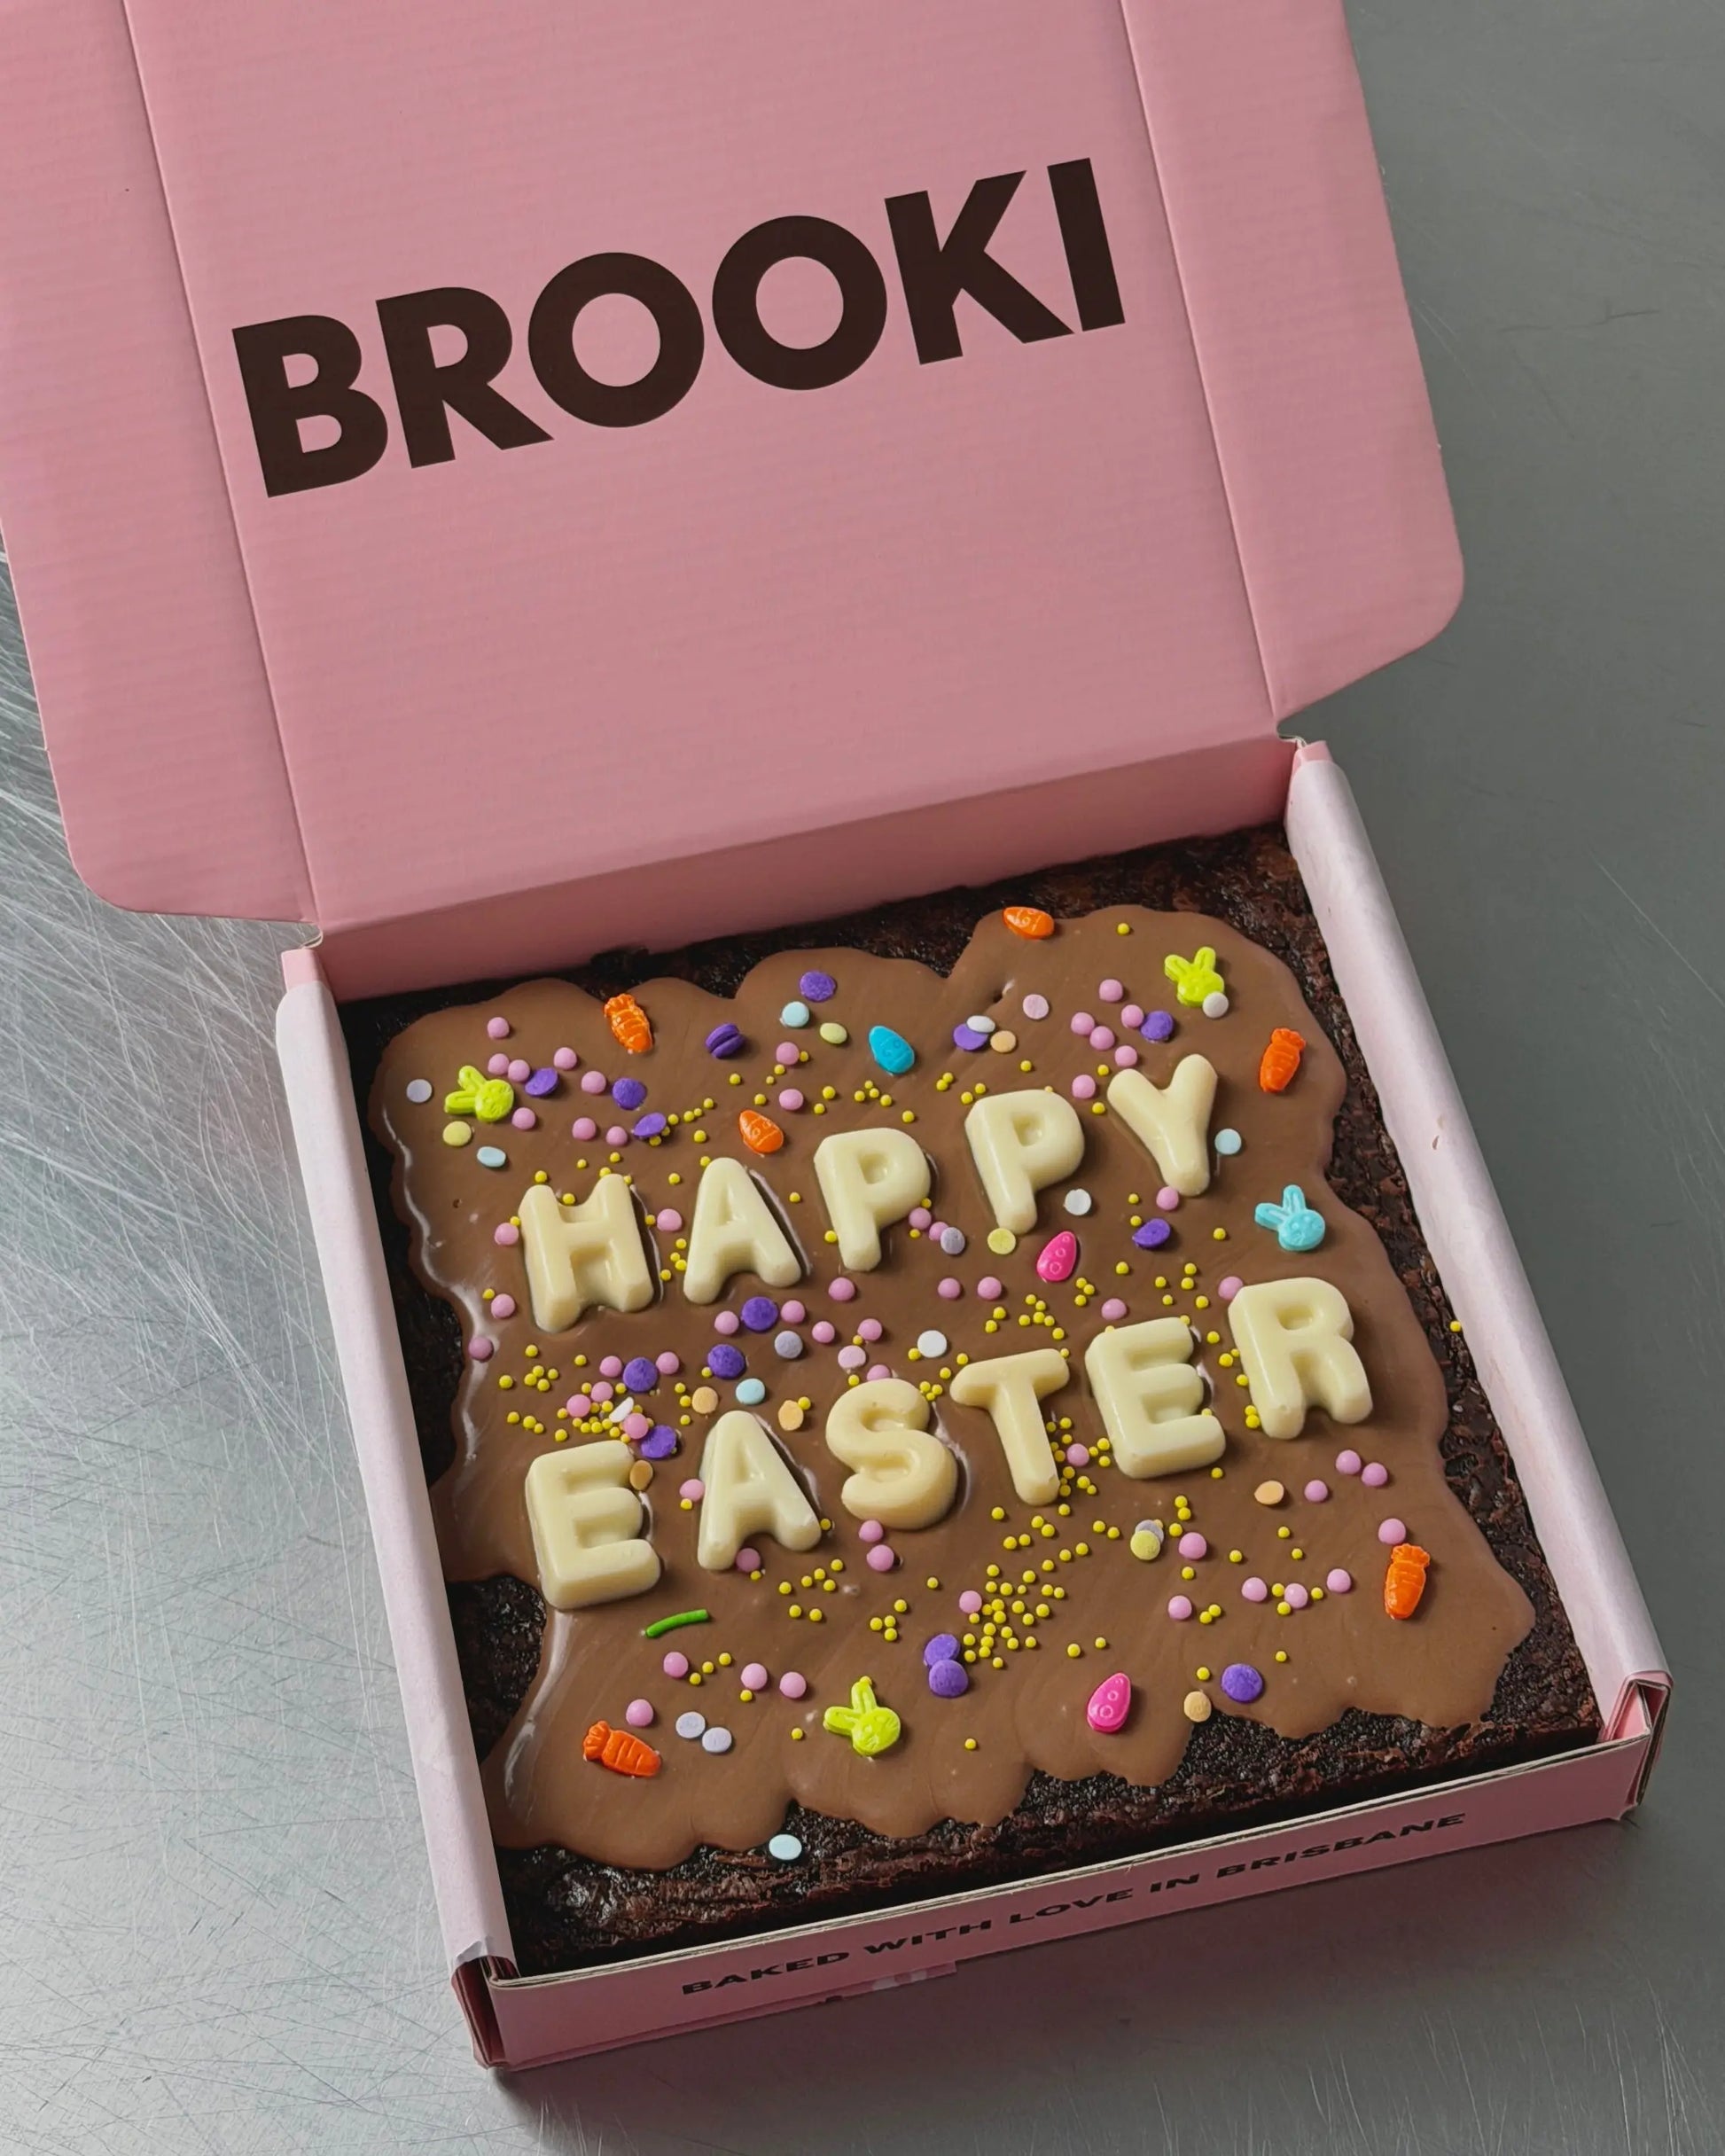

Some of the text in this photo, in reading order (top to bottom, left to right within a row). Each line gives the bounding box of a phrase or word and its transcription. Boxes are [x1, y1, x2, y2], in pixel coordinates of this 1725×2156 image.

[231, 158, 1126, 498] BROOKI
[519, 1054, 1218, 1333] HAPPY
[525, 1277, 1372, 1609] EASTER
[681, 1813, 1466, 1995] BAKED WITH LOVE IN BRISBANE
